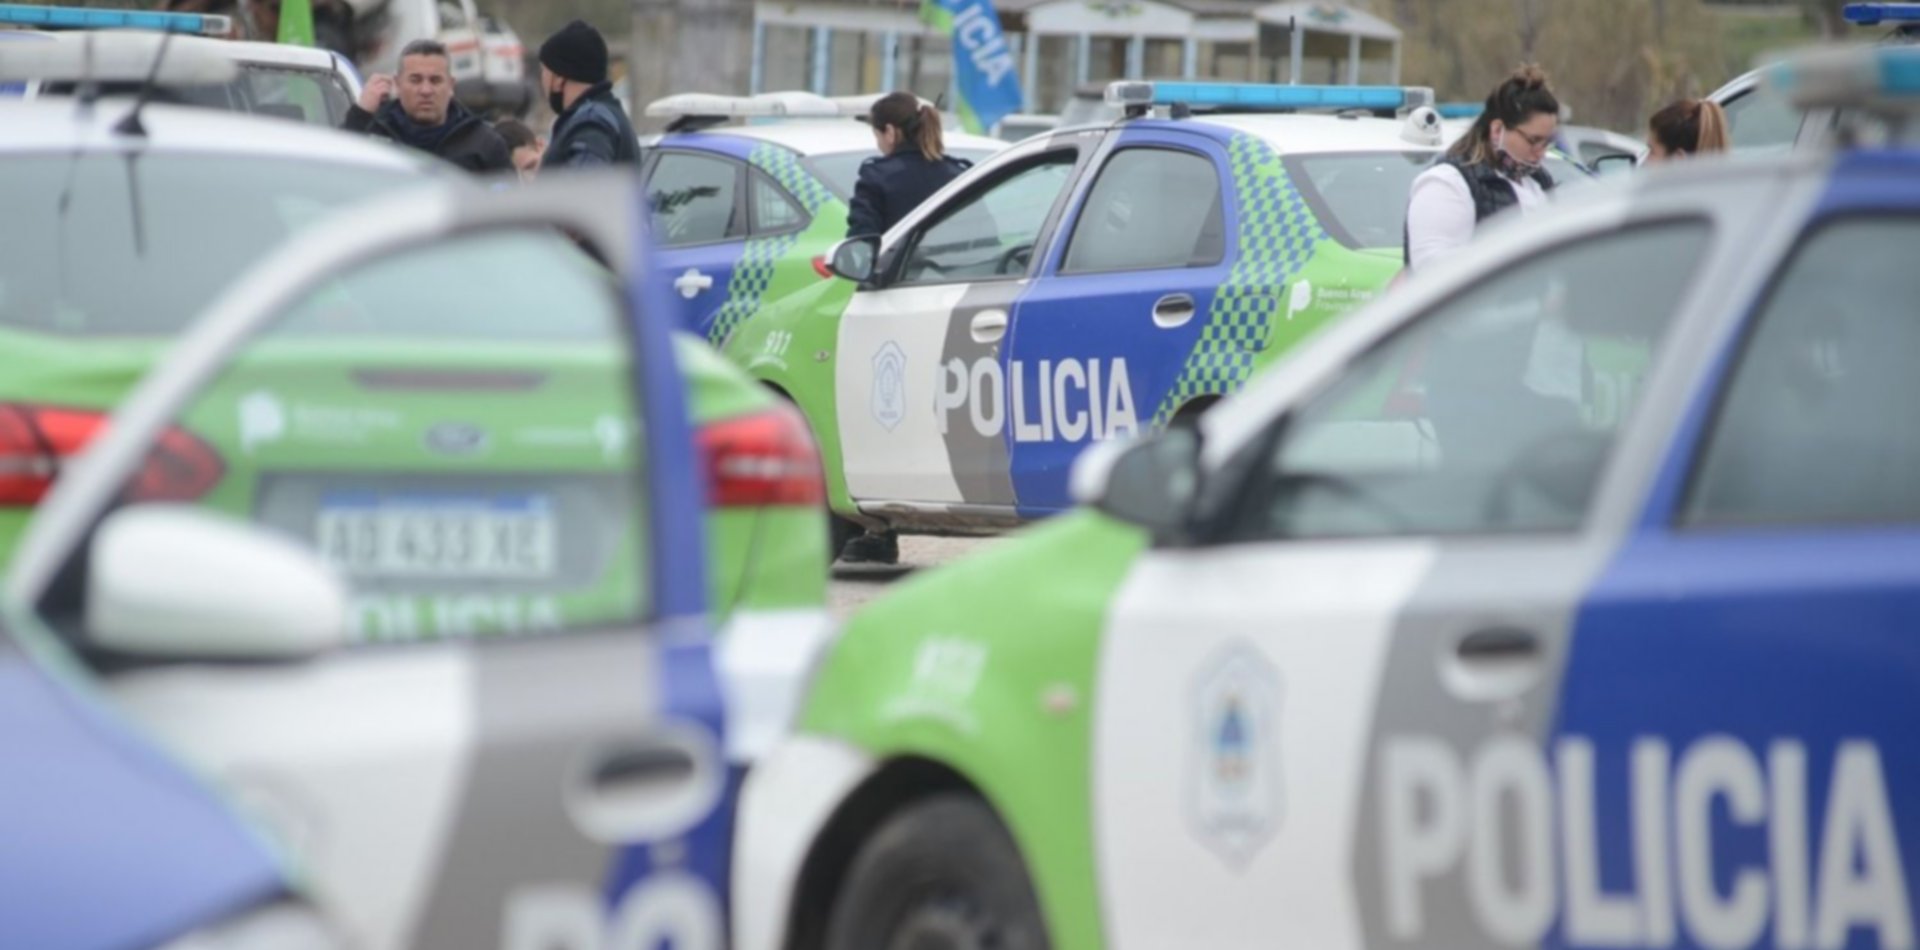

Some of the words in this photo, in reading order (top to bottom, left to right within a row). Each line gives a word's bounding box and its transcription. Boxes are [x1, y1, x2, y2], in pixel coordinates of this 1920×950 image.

[952, 0, 1012, 87] ICIA
[934, 357, 1139, 442] POLICIA
[1380, 735, 1917, 950] POLICIA
